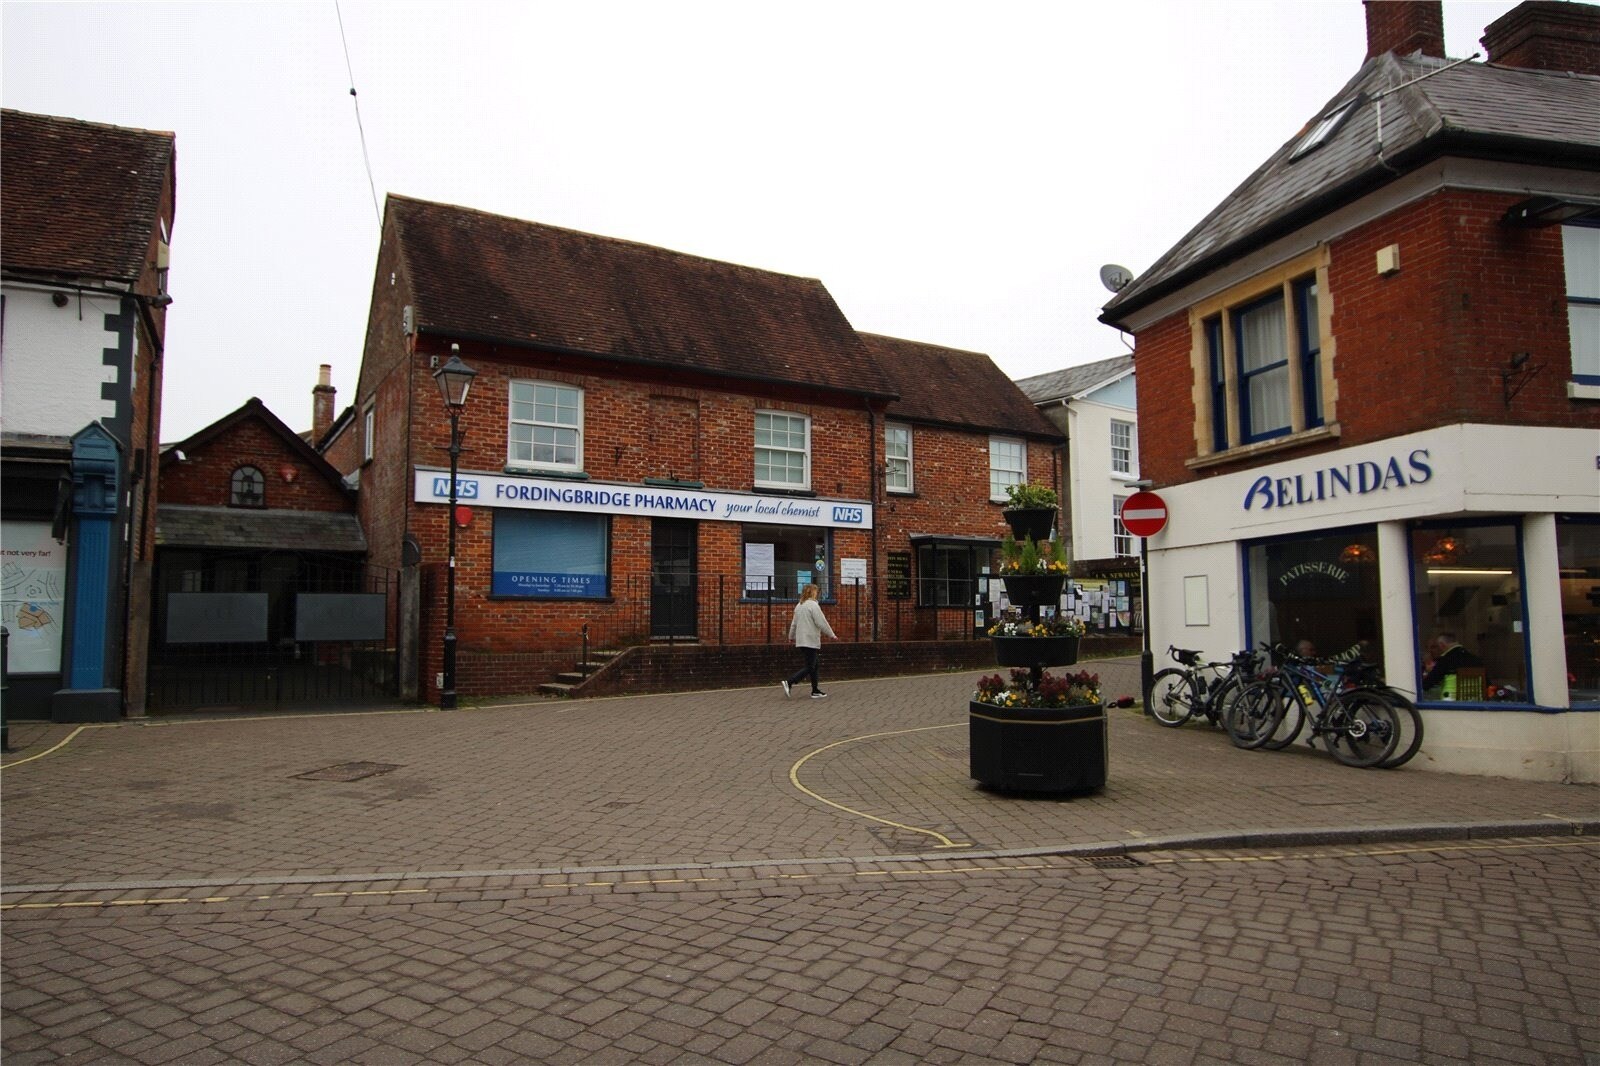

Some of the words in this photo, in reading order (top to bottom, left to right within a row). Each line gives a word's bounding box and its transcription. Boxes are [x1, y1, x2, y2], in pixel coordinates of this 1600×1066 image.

[434, 479, 477, 497] NHS
[1242, 448, 1433, 511] BELINDAS
[496, 484, 631, 507] FORDINGBRIDGE
[634, 493, 718, 513] PHARMACY
[723, 502, 753, 518] your
[755, 499, 780, 515] local
[781, 501, 821, 518] chemist
[834, 508, 862, 522] NHS
[21, 550, 37, 558] very
[511, 575, 557, 583] OPENING
[562, 576, 591, 584] TIMES
[1279, 561, 1350, 587] PATISSERIE
